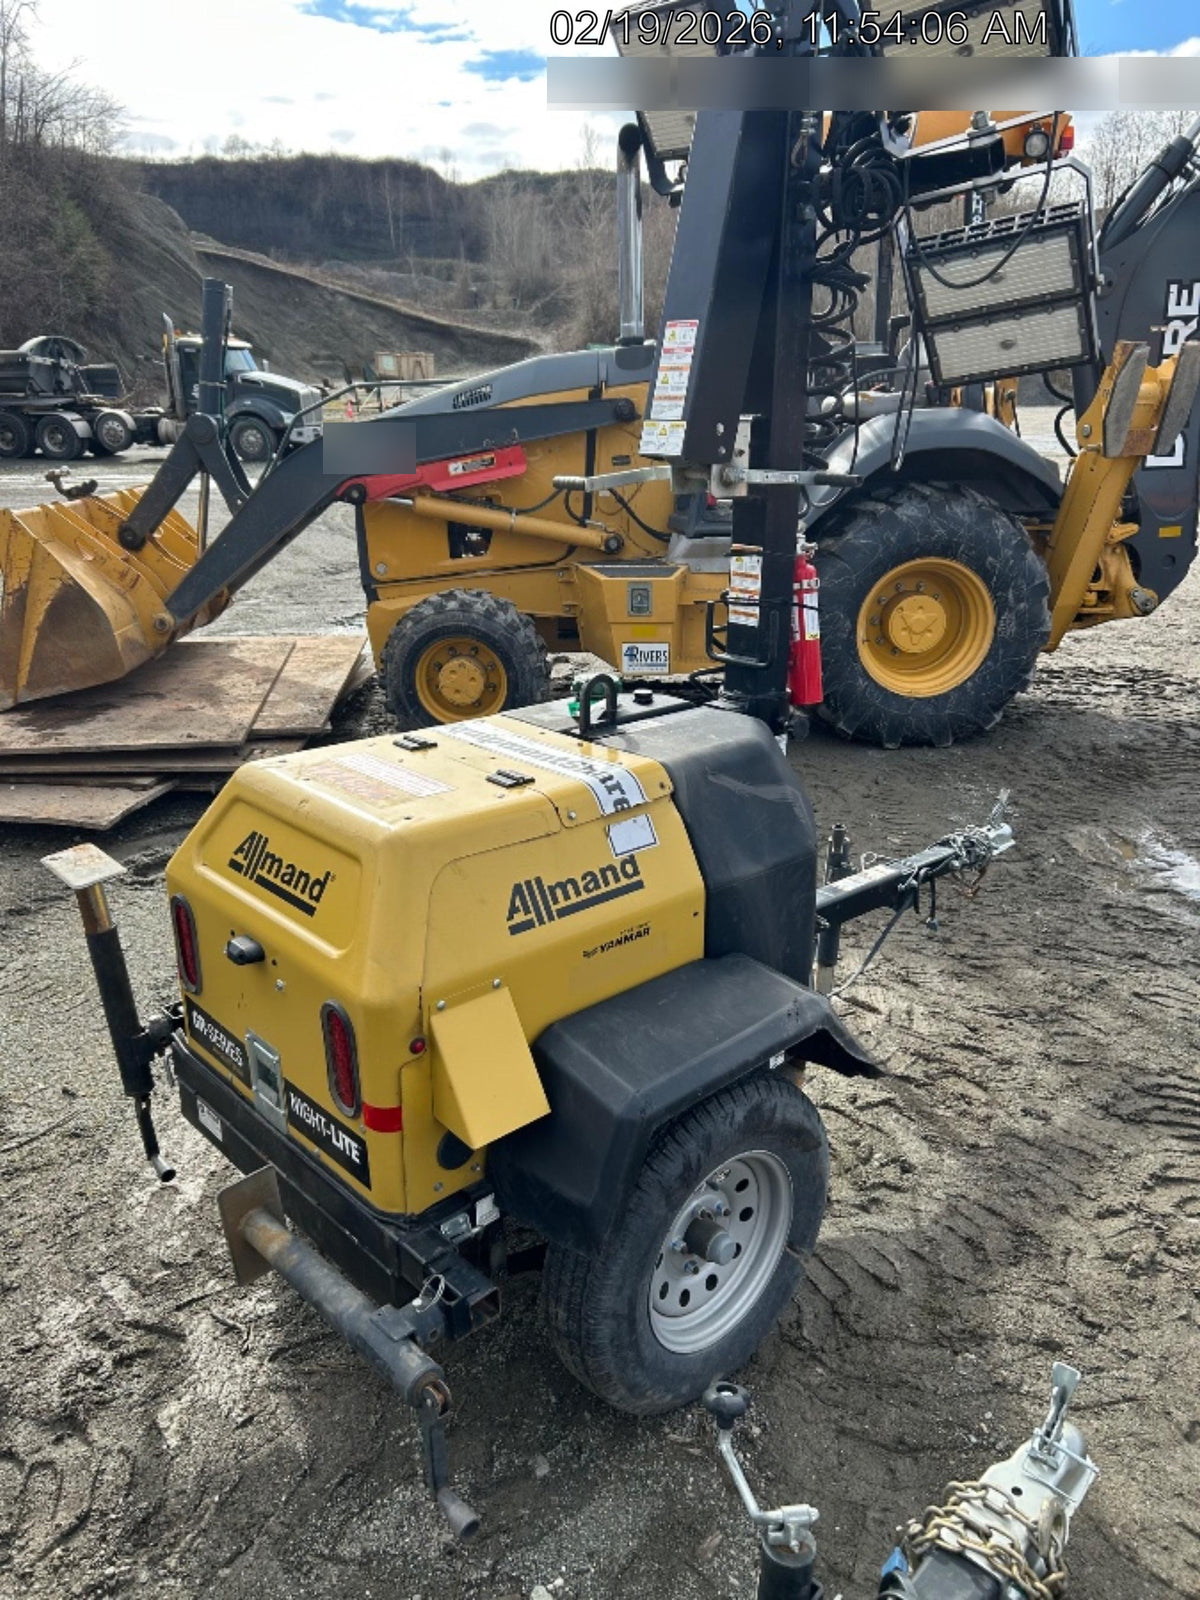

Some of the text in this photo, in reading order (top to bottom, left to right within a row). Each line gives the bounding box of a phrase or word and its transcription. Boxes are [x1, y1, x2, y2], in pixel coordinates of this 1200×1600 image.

[230, 830, 331, 906] Allmand
[506, 854, 641, 928] Allmand
[599, 926, 651, 953] YANMAR
[290, 1091, 361, 1164] NIGHT-LITE
